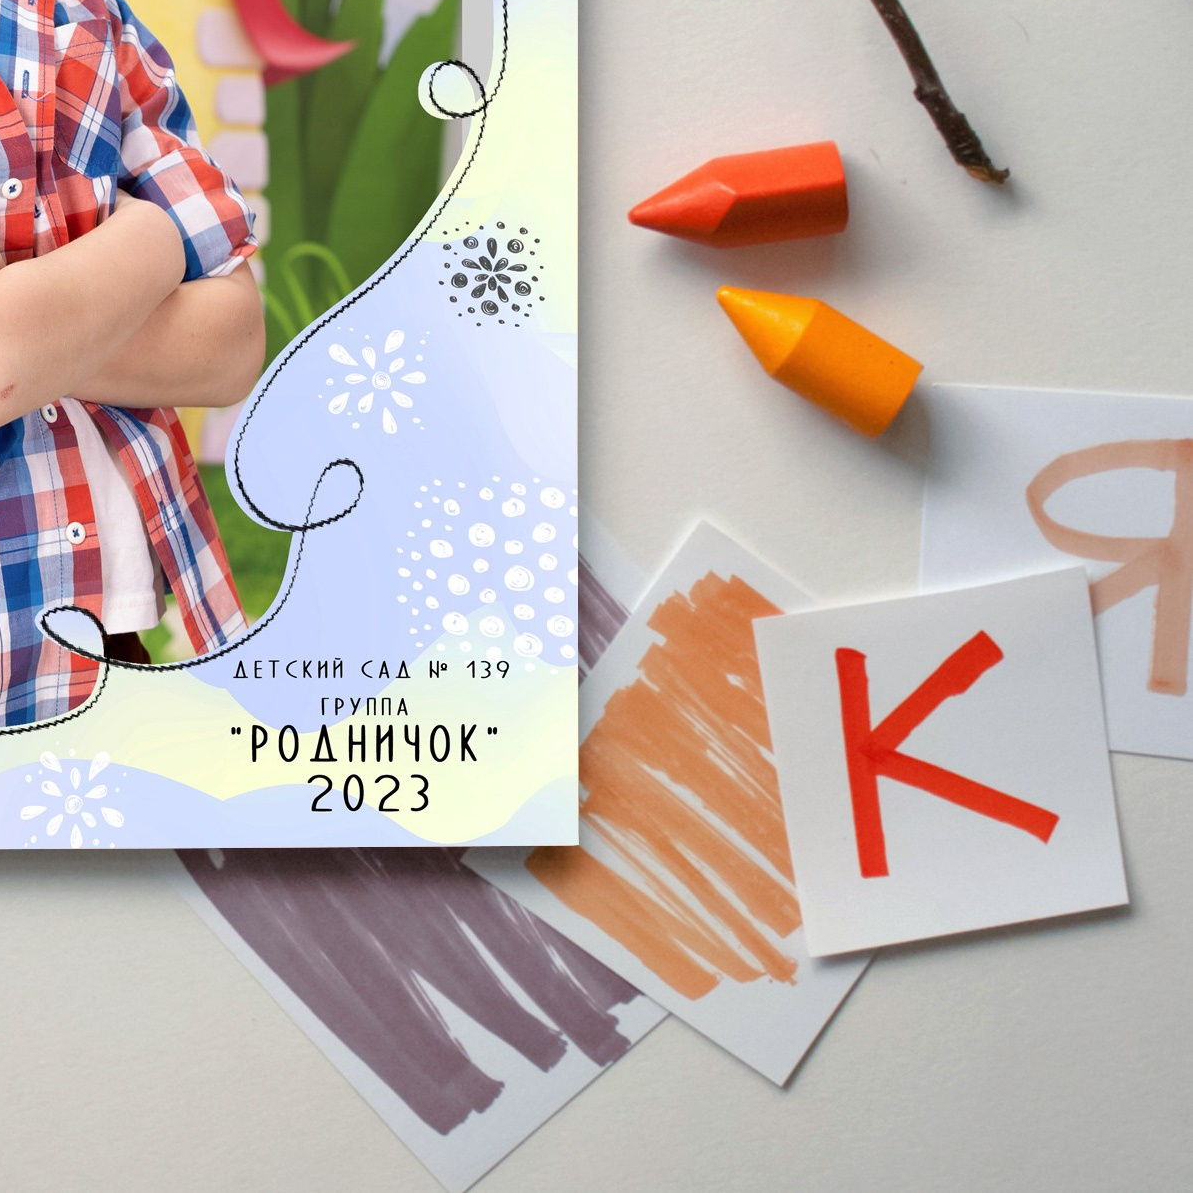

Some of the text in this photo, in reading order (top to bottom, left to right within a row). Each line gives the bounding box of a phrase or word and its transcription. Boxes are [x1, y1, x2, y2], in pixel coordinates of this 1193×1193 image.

[1025, 438, 1193, 696] Я
[232, 657, 510, 679] ДЕТСКИЙ САД № 139
[320, 697, 408, 716] ГРУППА
[230, 724, 498, 763] "РОДНИЧОК"
[834, 630, 1060, 879] К
[307, 774, 429, 812] 2023
